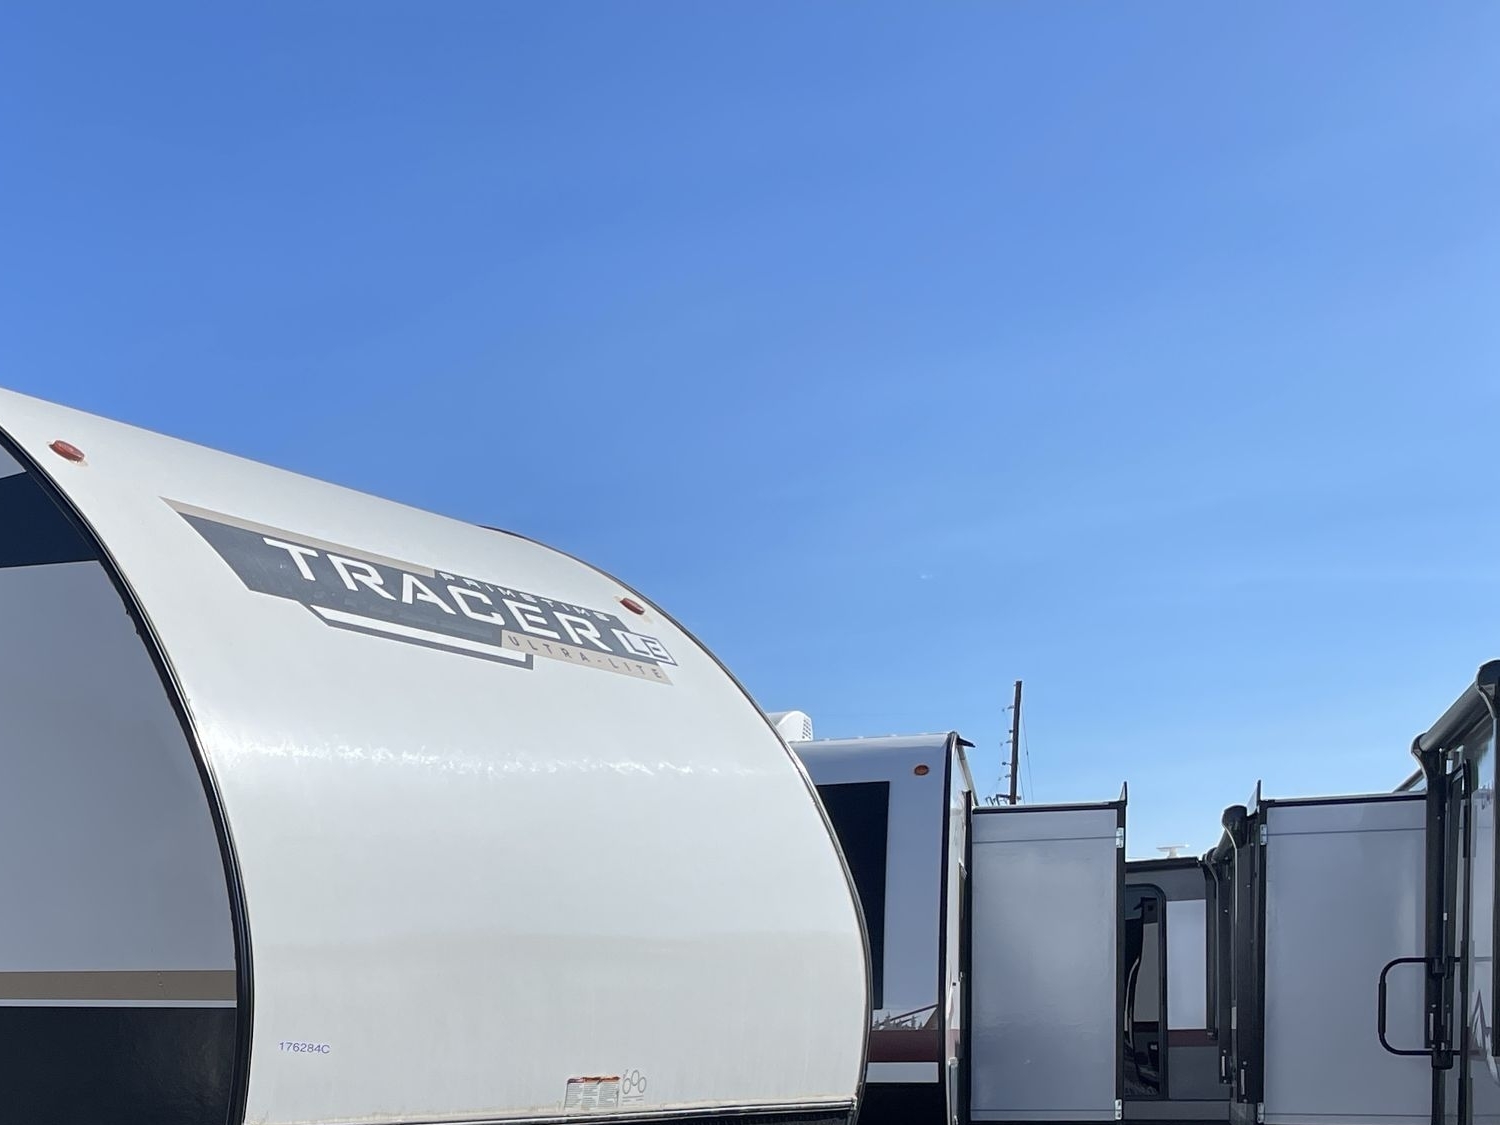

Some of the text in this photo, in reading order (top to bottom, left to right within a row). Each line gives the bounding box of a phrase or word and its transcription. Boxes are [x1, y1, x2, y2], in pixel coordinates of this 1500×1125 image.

[263, 536, 614, 652] TRACER
[507, 634, 663, 679] ULTRA-LITE
[279, 1041, 331, 1055] 176284C
